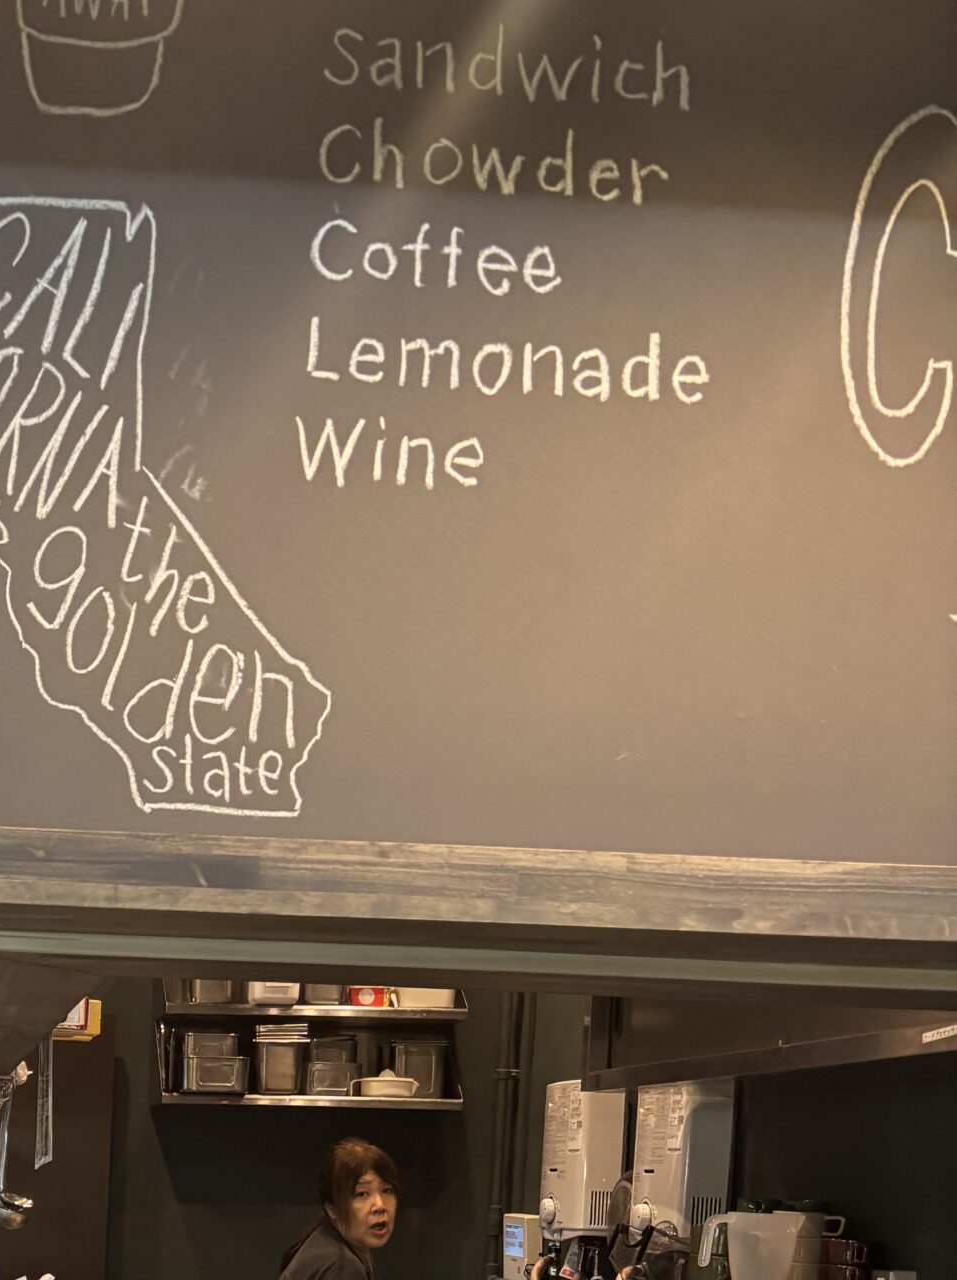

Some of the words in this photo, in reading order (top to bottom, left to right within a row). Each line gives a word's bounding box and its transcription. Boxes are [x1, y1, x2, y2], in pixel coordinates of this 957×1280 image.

[324, 23, 690, 111] Sandwich
[319, 117, 669, 205] Chowder
[310, 219, 562, 296] Coffee
[307, 317, 710, 404] Lemonade
[296, 415, 484, 490] Wine
[121, 496, 216, 637] the
[142, 732, 283, 803] state
